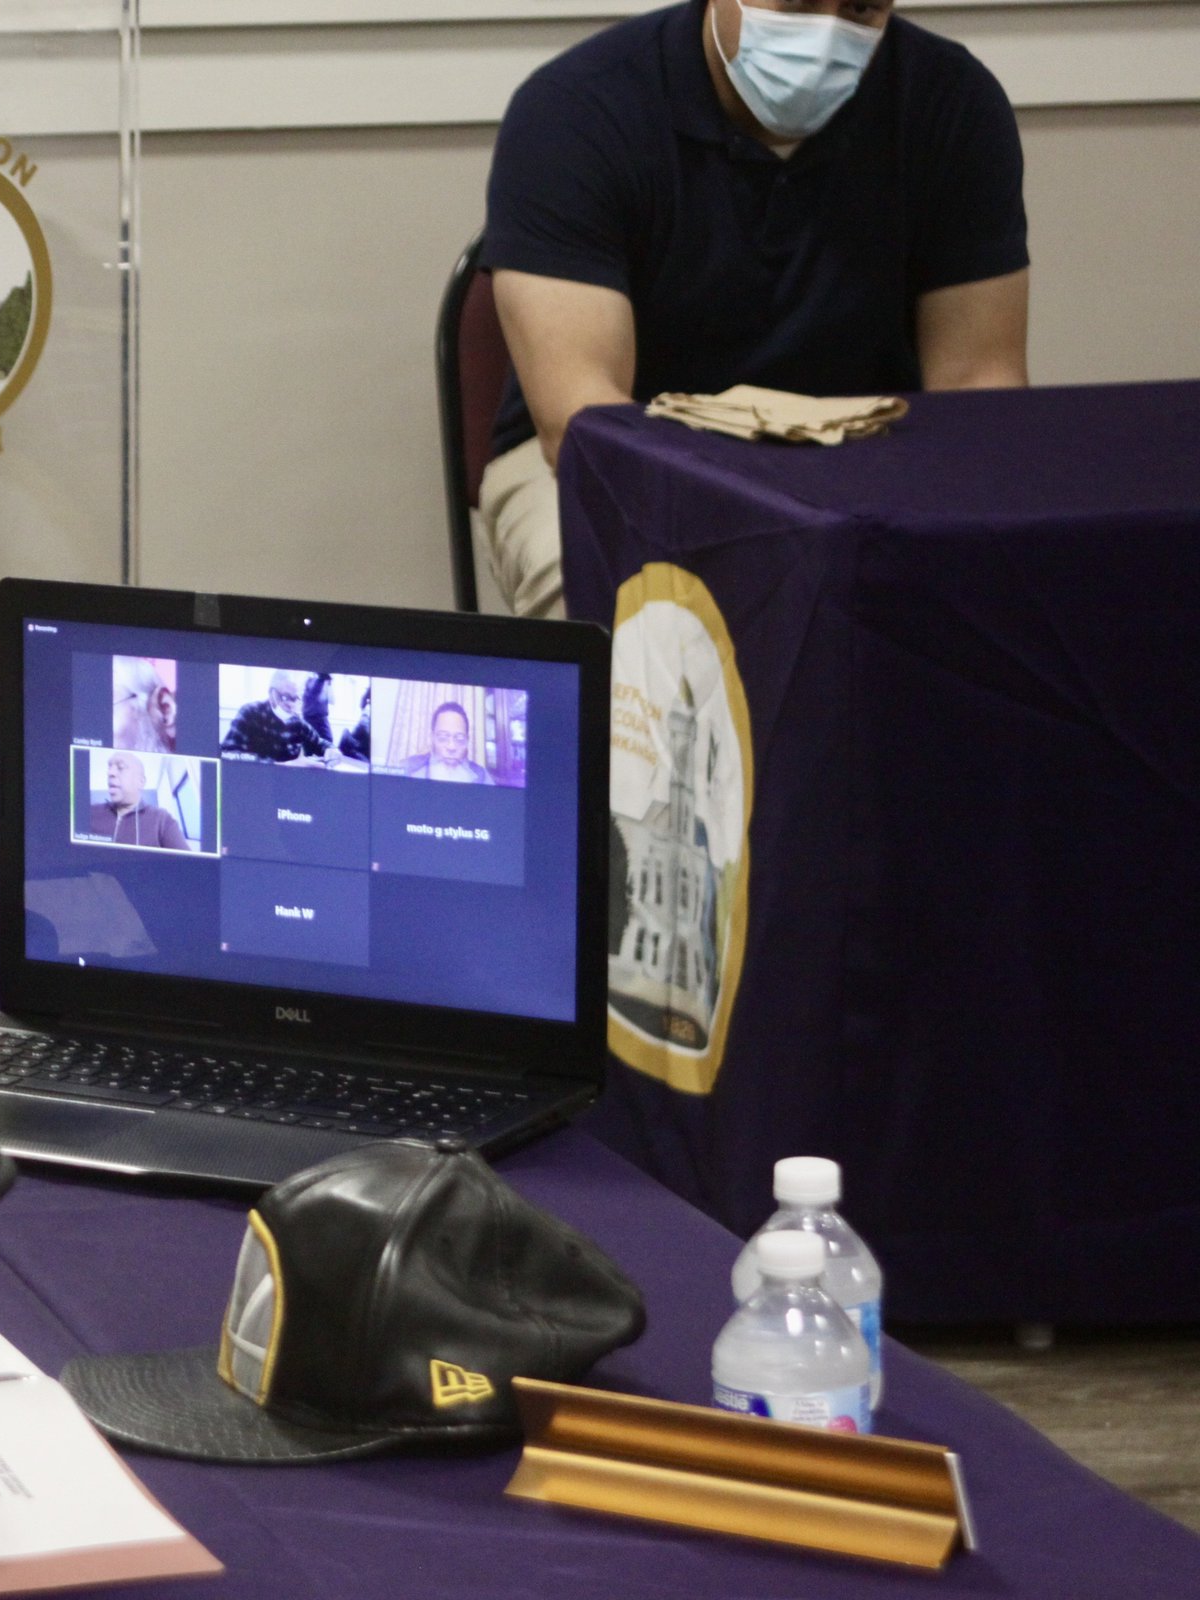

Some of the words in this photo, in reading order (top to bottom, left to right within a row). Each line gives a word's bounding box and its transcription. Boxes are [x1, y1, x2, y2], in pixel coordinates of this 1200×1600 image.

[277, 807, 313, 823] iPhone
[406, 823, 434, 835] moto
[434, 826, 443, 838] g
[443, 826, 474, 840] stylus
[274, 904, 301, 919] Hank
[301, 907, 315, 920] W
[275, 1006, 311, 1023] DELL
